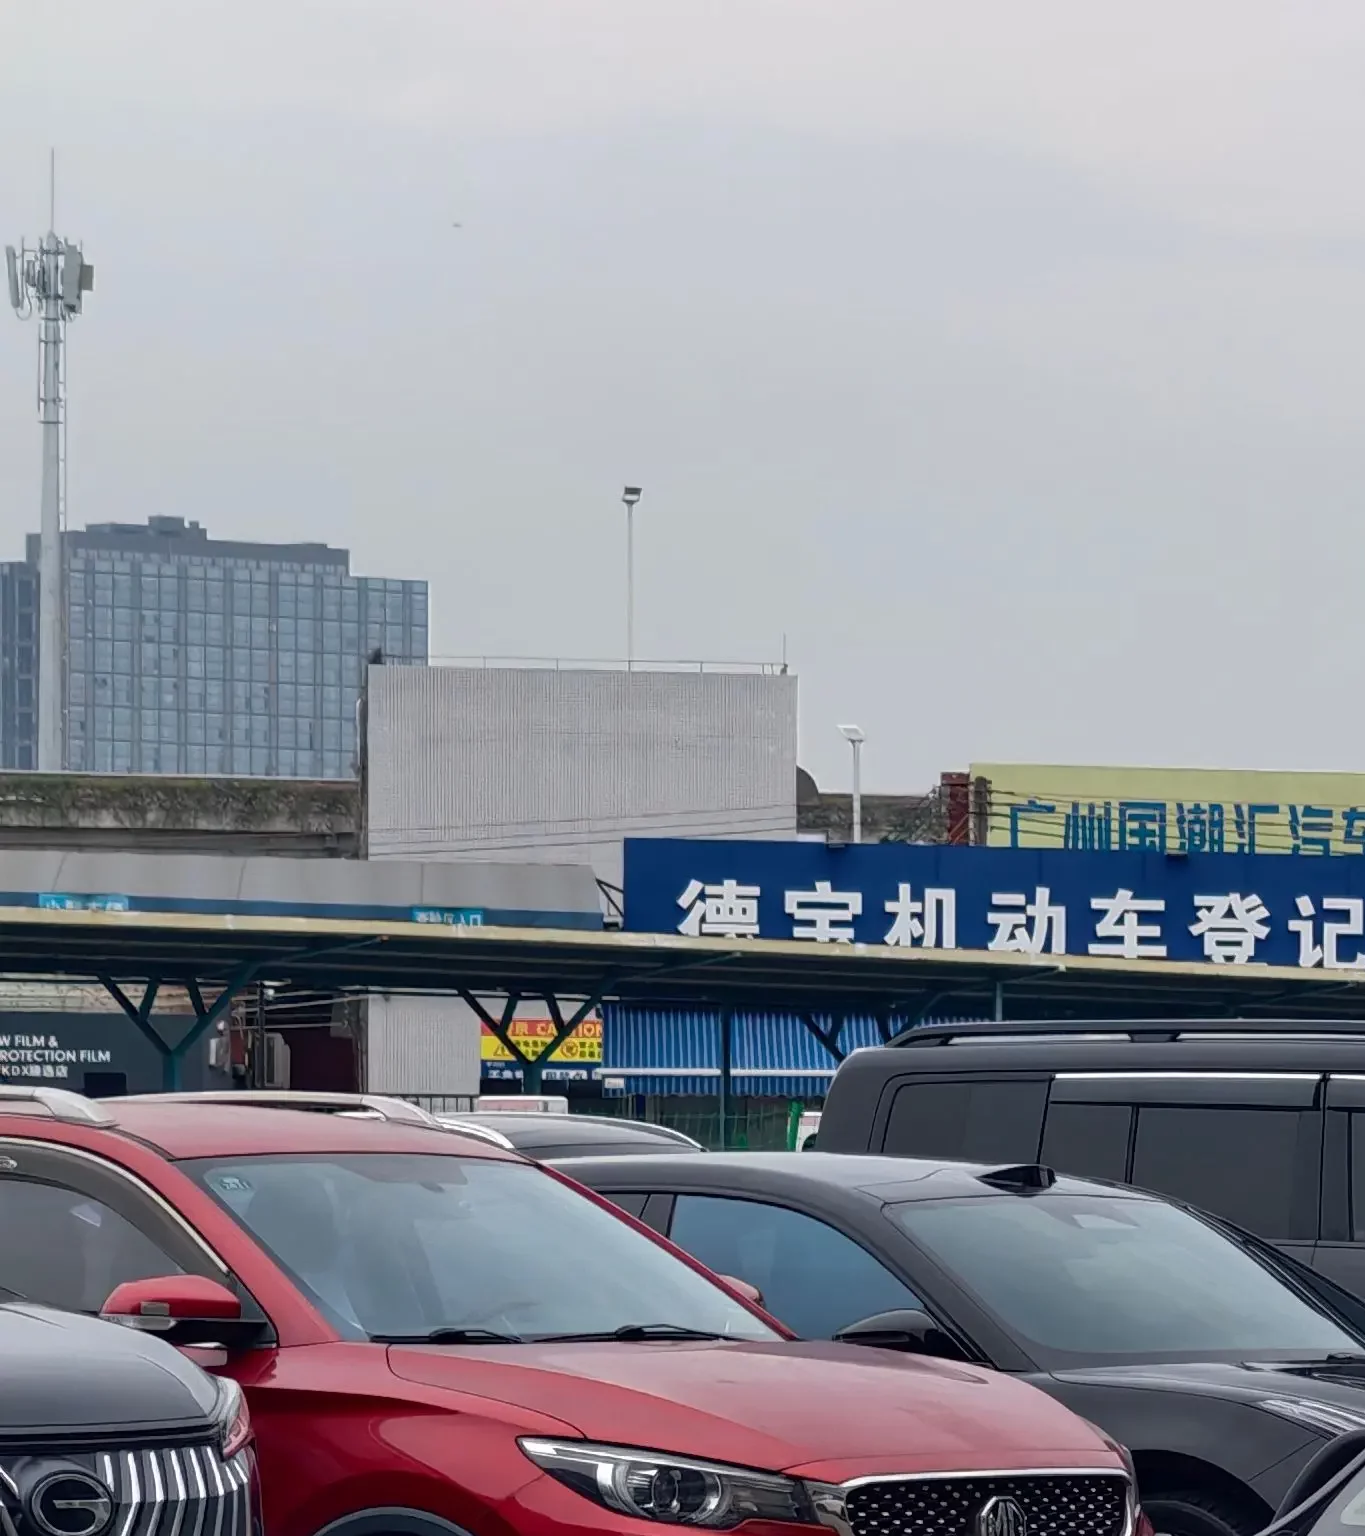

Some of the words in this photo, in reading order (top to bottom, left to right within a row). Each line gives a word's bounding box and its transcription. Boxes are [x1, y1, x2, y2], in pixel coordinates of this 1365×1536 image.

[15, 1035, 45, 1047] FILM
[48, 1036, 58, 1048] &
[80, 1050, 111, 1063] FILM
